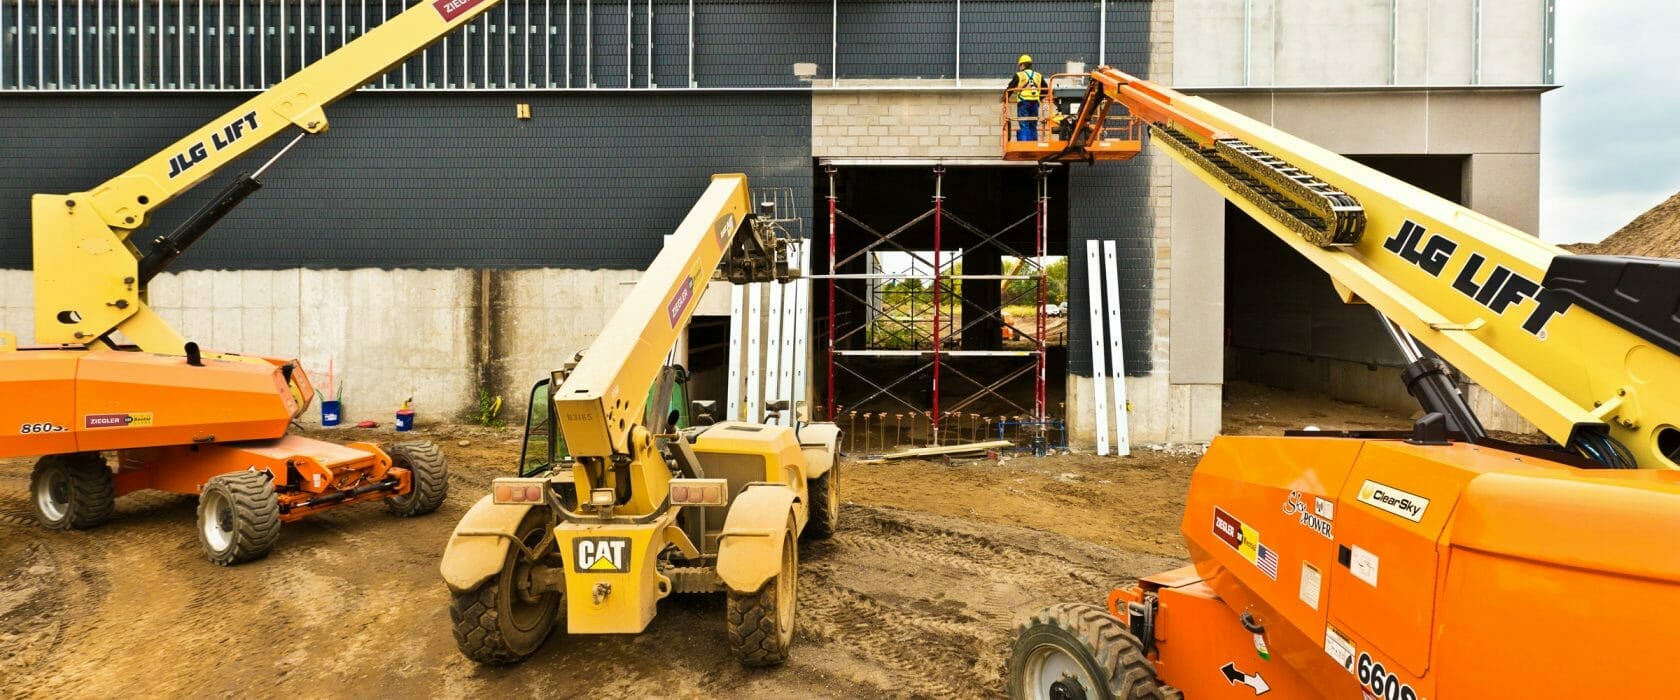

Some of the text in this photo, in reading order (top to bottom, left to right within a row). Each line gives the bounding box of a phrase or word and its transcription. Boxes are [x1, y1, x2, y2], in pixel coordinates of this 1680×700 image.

[168, 111, 258, 179] JLG LIFT
[1383, 219, 1573, 336] JLG LIFT
[90, 417, 120, 425] ZIEGLER
[1373, 489, 1421, 517] ClearSky
[1302, 512, 1331, 538] POWER
[578, 540, 626, 570] CAT
